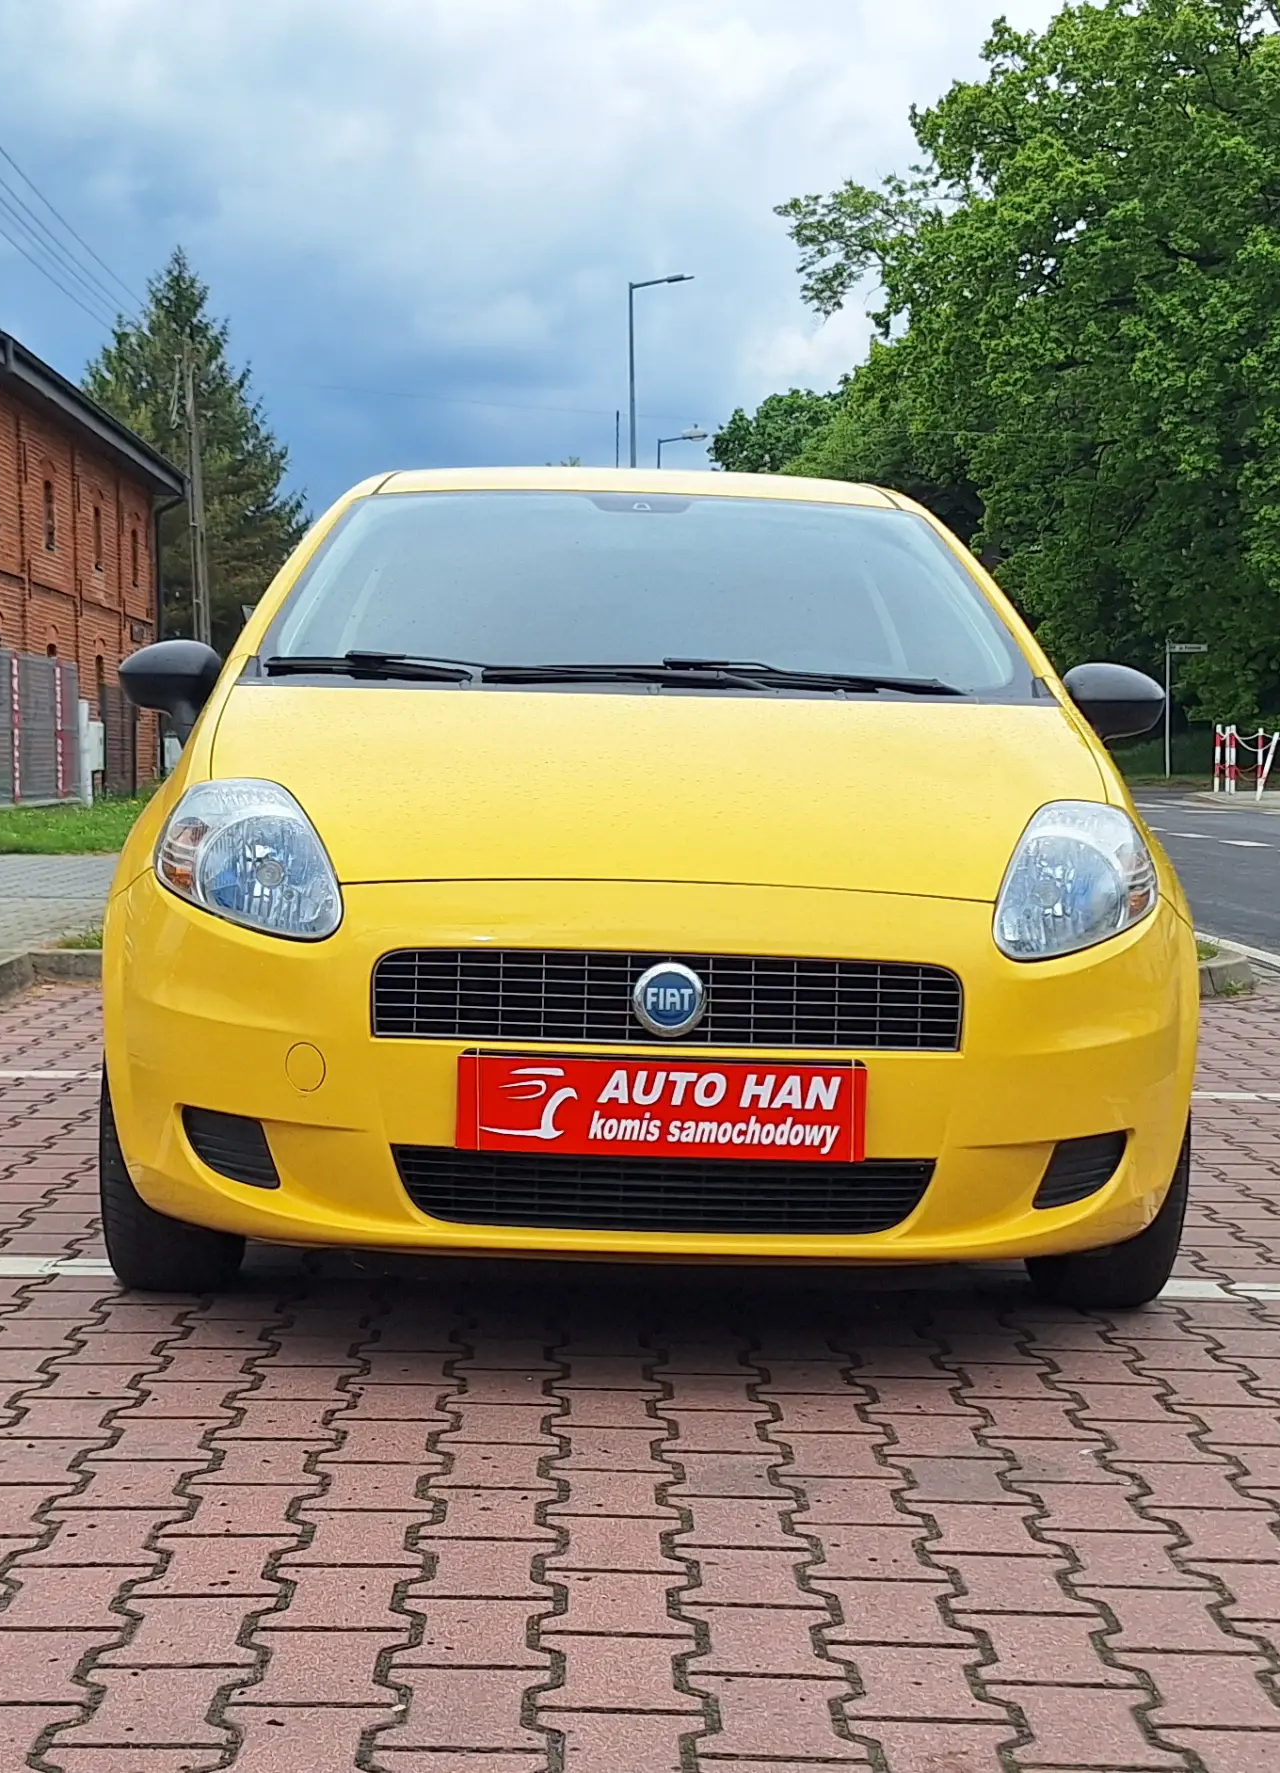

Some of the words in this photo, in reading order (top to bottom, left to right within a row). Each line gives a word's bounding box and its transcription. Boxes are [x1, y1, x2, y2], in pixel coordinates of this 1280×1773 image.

[646, 987, 695, 1012] FIAT
[597, 1069, 727, 1109] AUTO
[739, 1075, 842, 1111] HAN
[588, 1110, 662, 1143] komis
[666, 1115, 841, 1155] samochodowy
